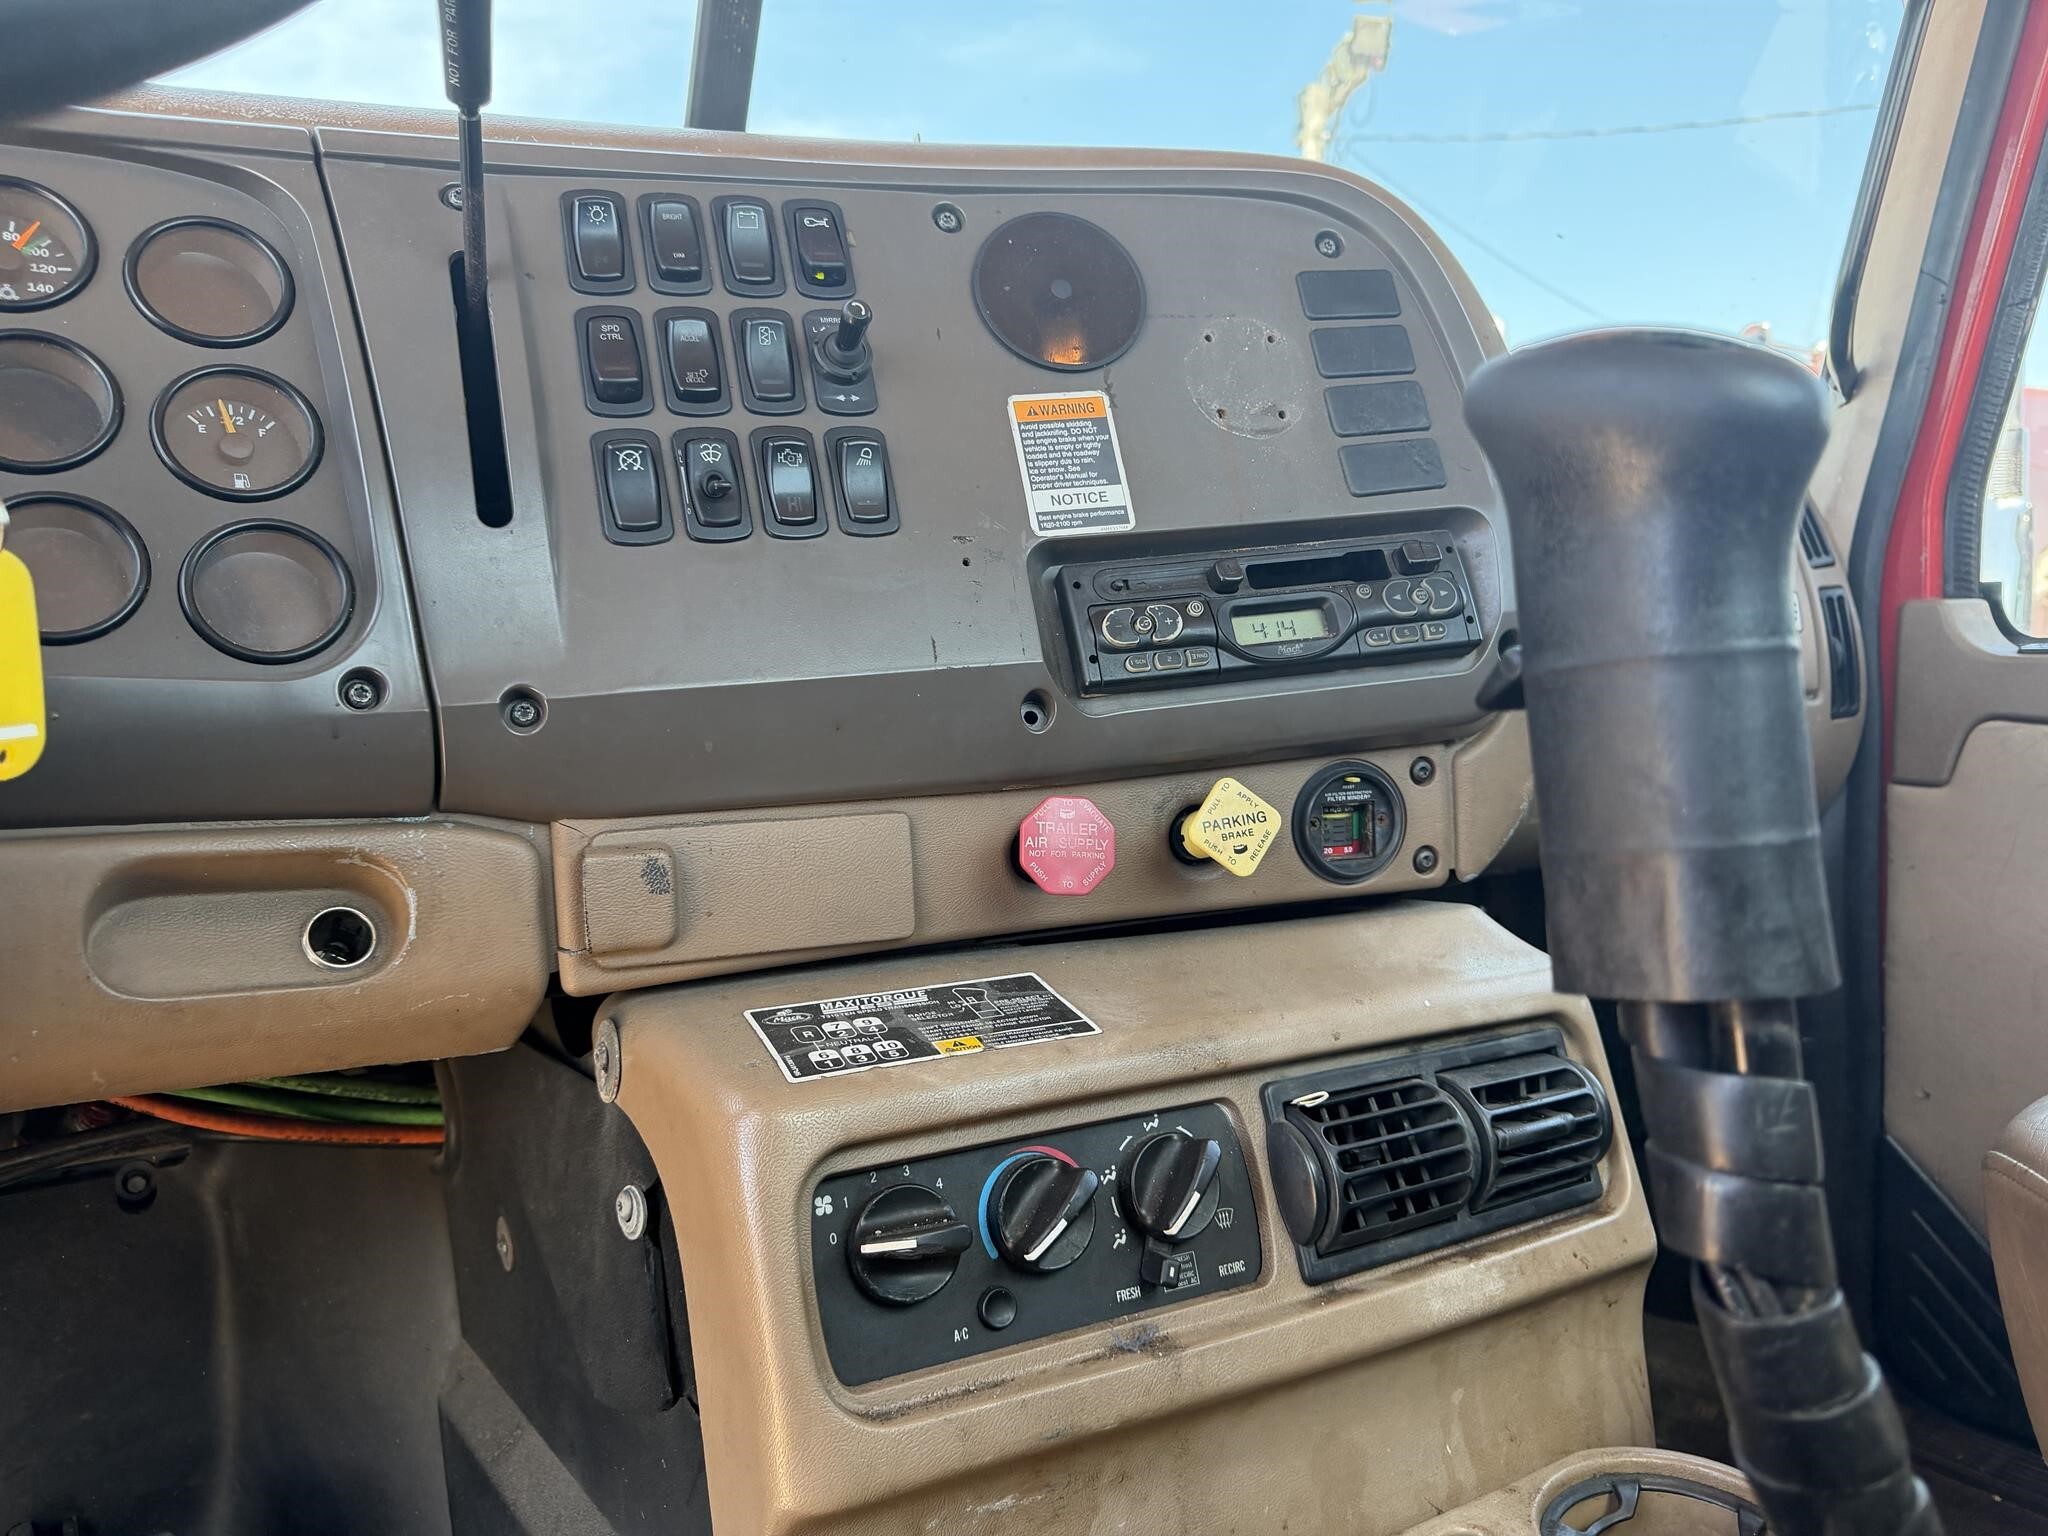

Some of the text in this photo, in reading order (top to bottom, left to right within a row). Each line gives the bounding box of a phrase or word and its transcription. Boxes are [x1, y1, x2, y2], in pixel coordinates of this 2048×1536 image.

[446, 29, 458, 55] FOR
[448, 60, 460, 87] NOT
[2, 231, 20, 241] 80
[29, 263, 57, 274] 120
[27, 282, 54, 294] 140
[601, 324, 620, 332] SPD
[600, 333, 624, 341] CTRL
[1039, 402, 1096, 416] WARNING
[198, 424, 207, 433] E
[258, 429, 267, 437] F
[1051, 491, 1109, 506] NOTICE
[1207, 782, 1260, 816] PULL TO APPLY
[1033, 803, 1051, 820] PULL
[1079, 800, 1111, 833] EVACUATE
[1202, 810, 1267, 833] PARKING
[1036, 821, 1098, 836] TRAILER
[1221, 828, 1254, 842] BRAKE
[1025, 837, 1109, 850] AIR SUPPLY
[1204, 829, 1272, 866] PUSH TO RELEASE
[1071, 852, 1106, 860] PARKING
[1029, 861, 1106, 888] PUSH TO SUPPLY
[820, 990, 928, 1011] MAXITORQUE
[773, 1014, 804, 1024] Mack
[825, 1037, 873, 1047] NEUTRAL
[945, 1044, 981, 1053] CAUTION
[843, 1164, 943, 1209] 1 2 3 4
[829, 1232, 837, 1245] 0
[1218, 1260, 1246, 1277] RECIRC
[1116, 1285, 1141, 1302] FRESH
